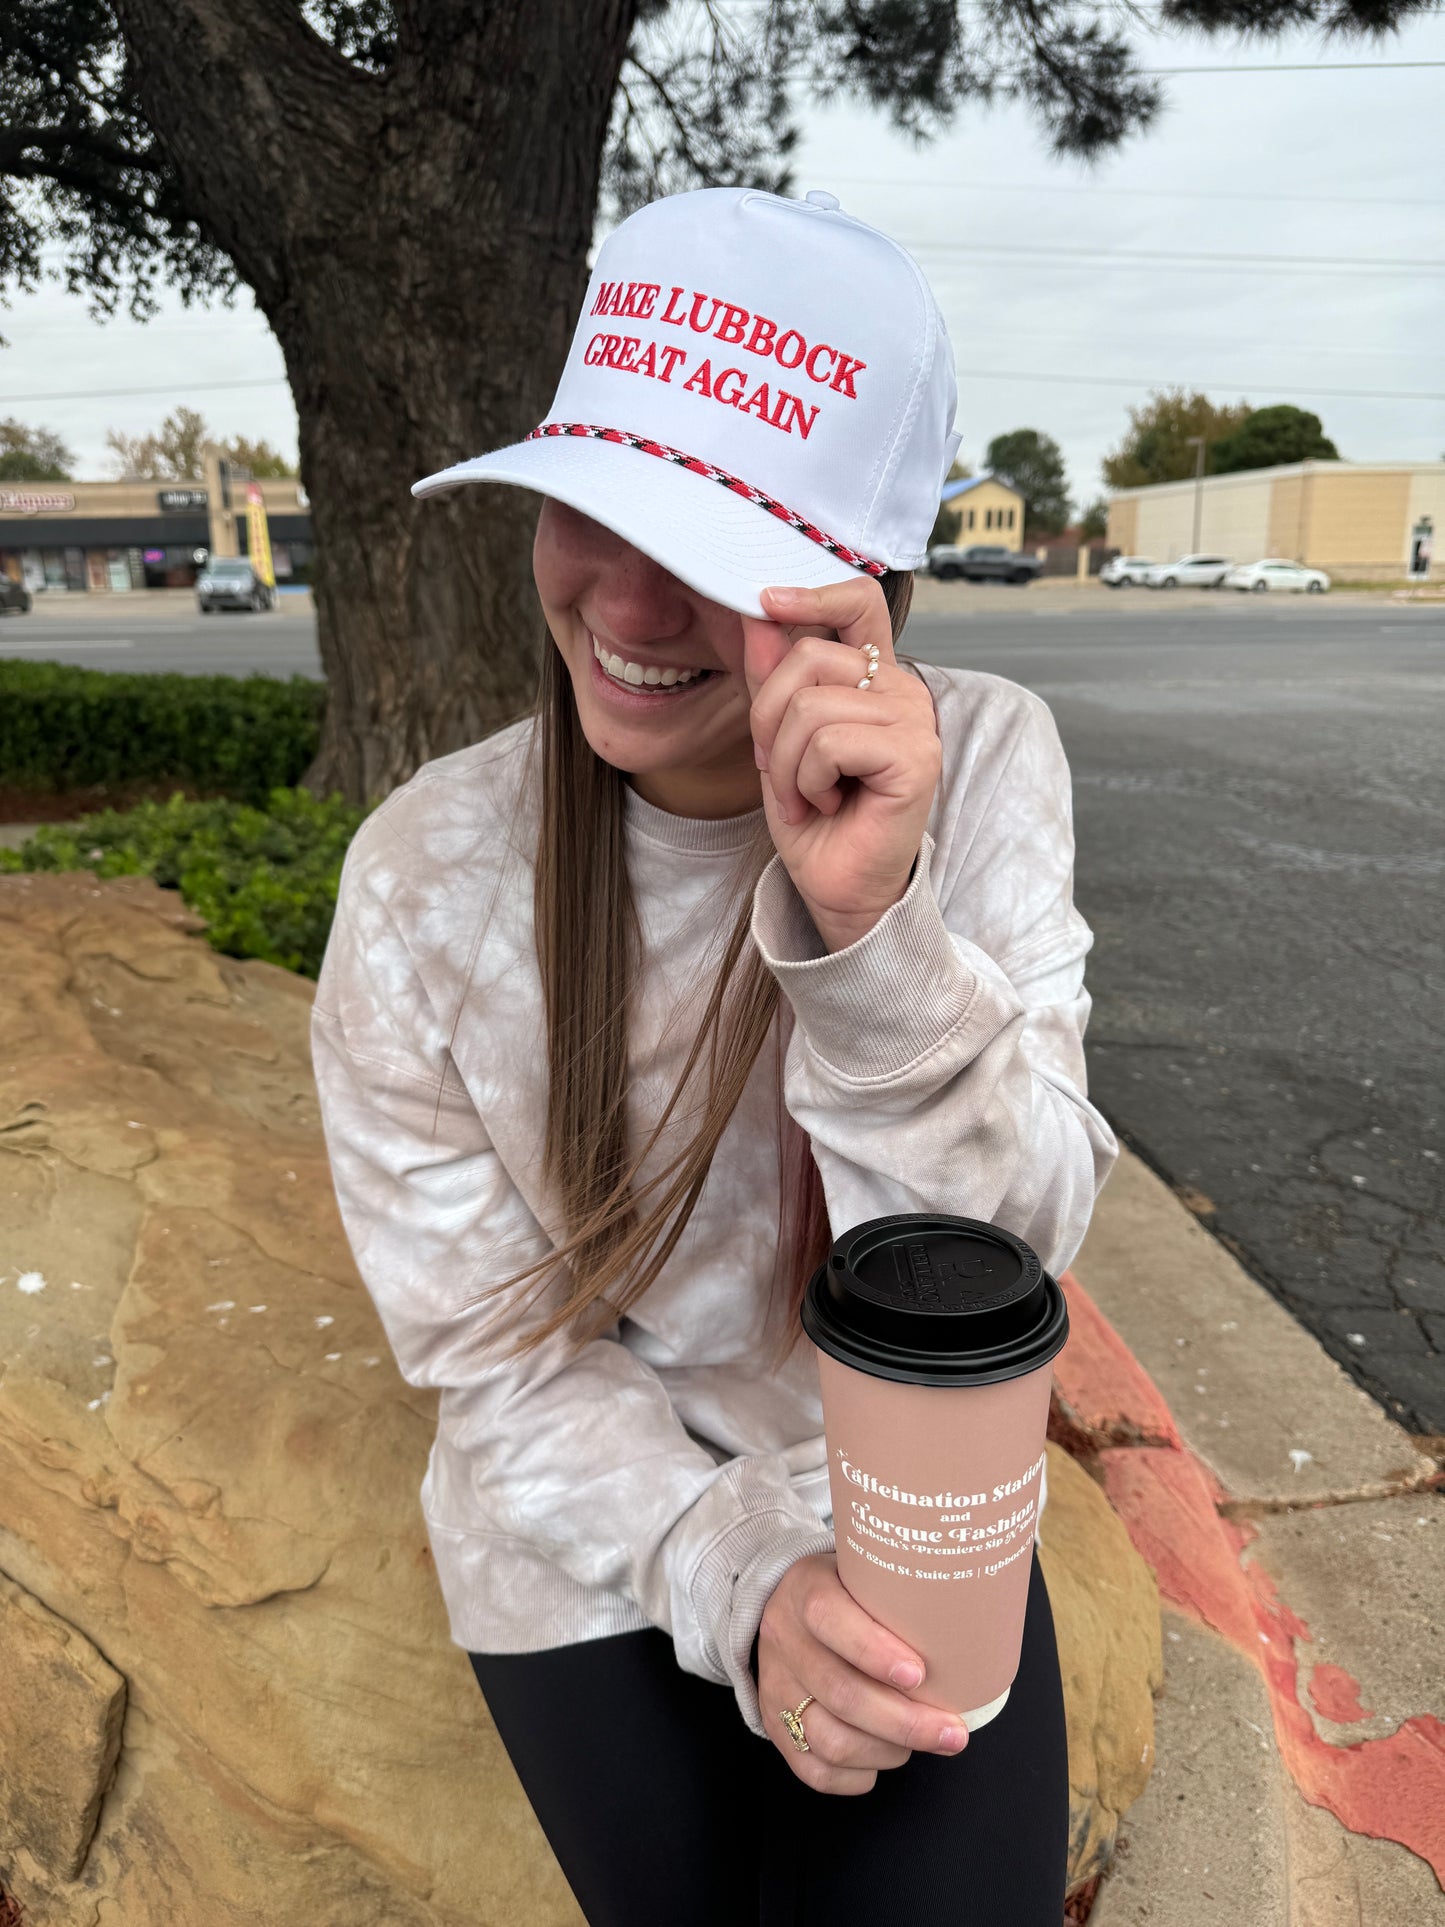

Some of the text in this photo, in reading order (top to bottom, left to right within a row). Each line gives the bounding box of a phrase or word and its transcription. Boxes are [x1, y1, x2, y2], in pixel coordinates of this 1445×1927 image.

[590, 281, 867, 400] MAKE LUBBOCK
[584, 333, 820, 440] GREAT AGAIN
[841, 1451, 1045, 1508] Caffeination Station
[851, 1499, 1034, 1543] Torque Fashion
[851, 1516, 910, 1552] Lubbock's
[911, 1542, 983, 1555] Premiere
[985, 1538, 1003, 1551] Sip
[939, 1511, 971, 1523] and
[866, 1551, 895, 1572] 82nd
[898, 1565, 913, 1577] St.
[915, 1569, 950, 1580] Suite
[952, 1568, 974, 1580] 215
